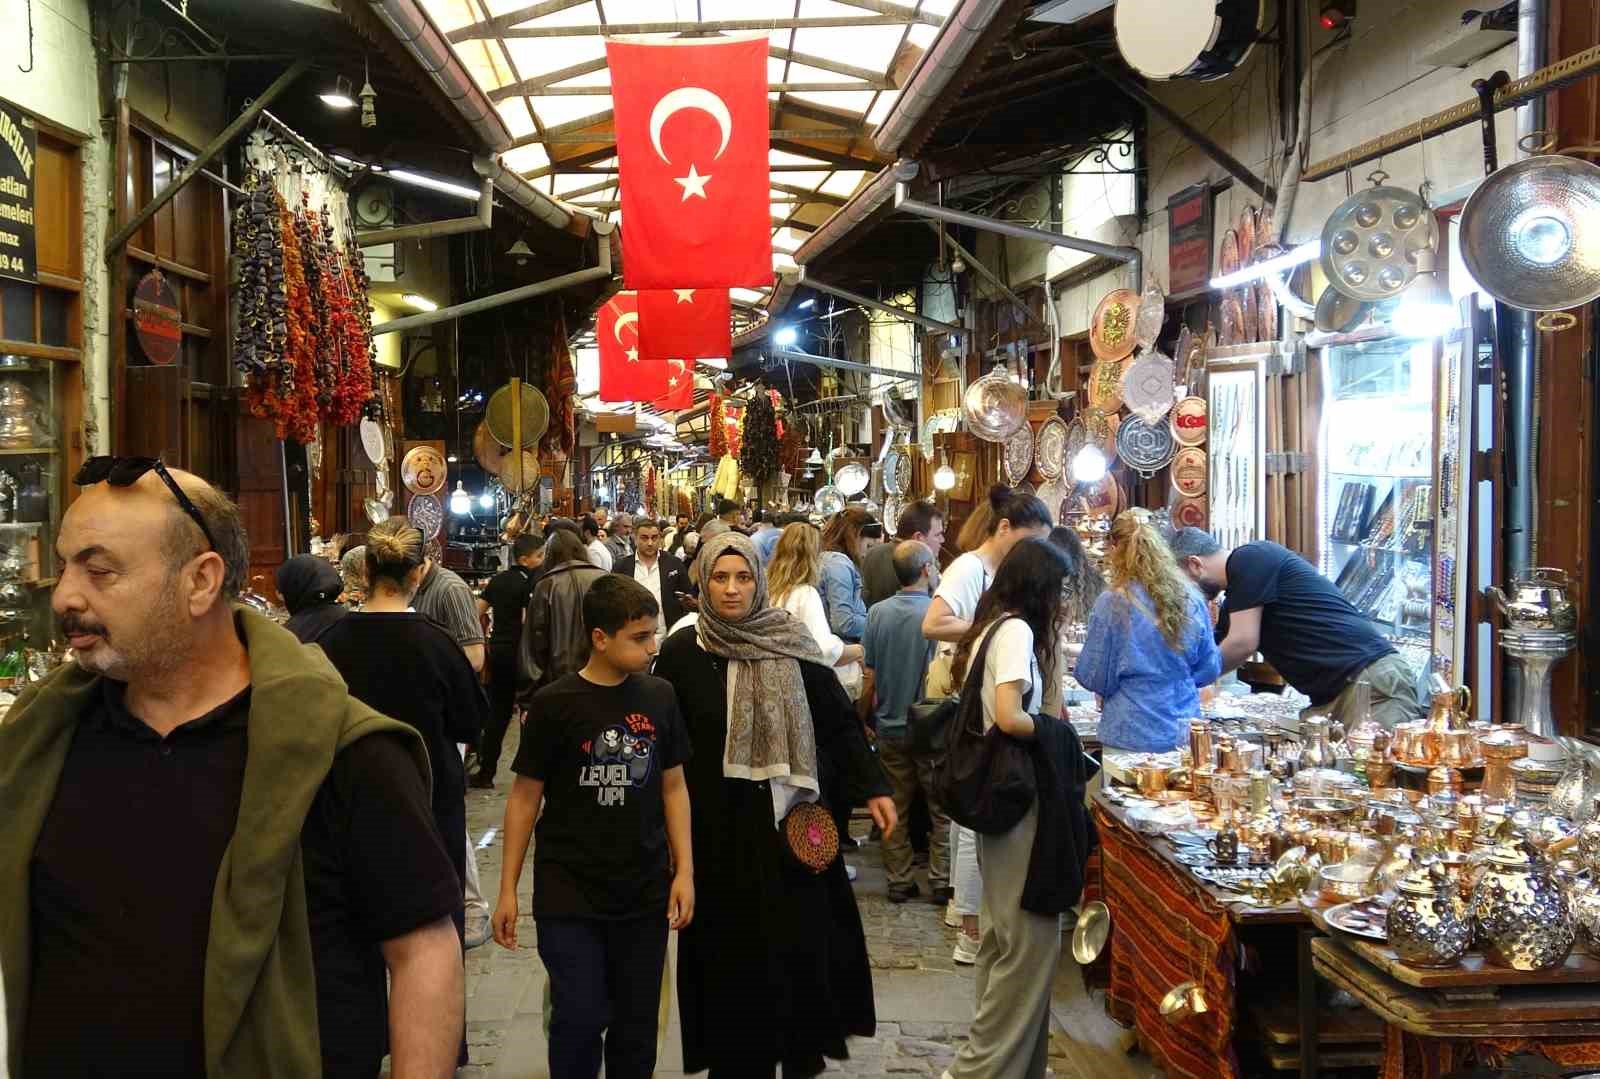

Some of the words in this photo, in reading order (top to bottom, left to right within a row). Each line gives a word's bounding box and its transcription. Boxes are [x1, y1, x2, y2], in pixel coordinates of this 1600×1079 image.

[11, 257, 24, 273] 44
[579, 764, 633, 786] LEVEL
[597, 786, 625, 806] UP!
